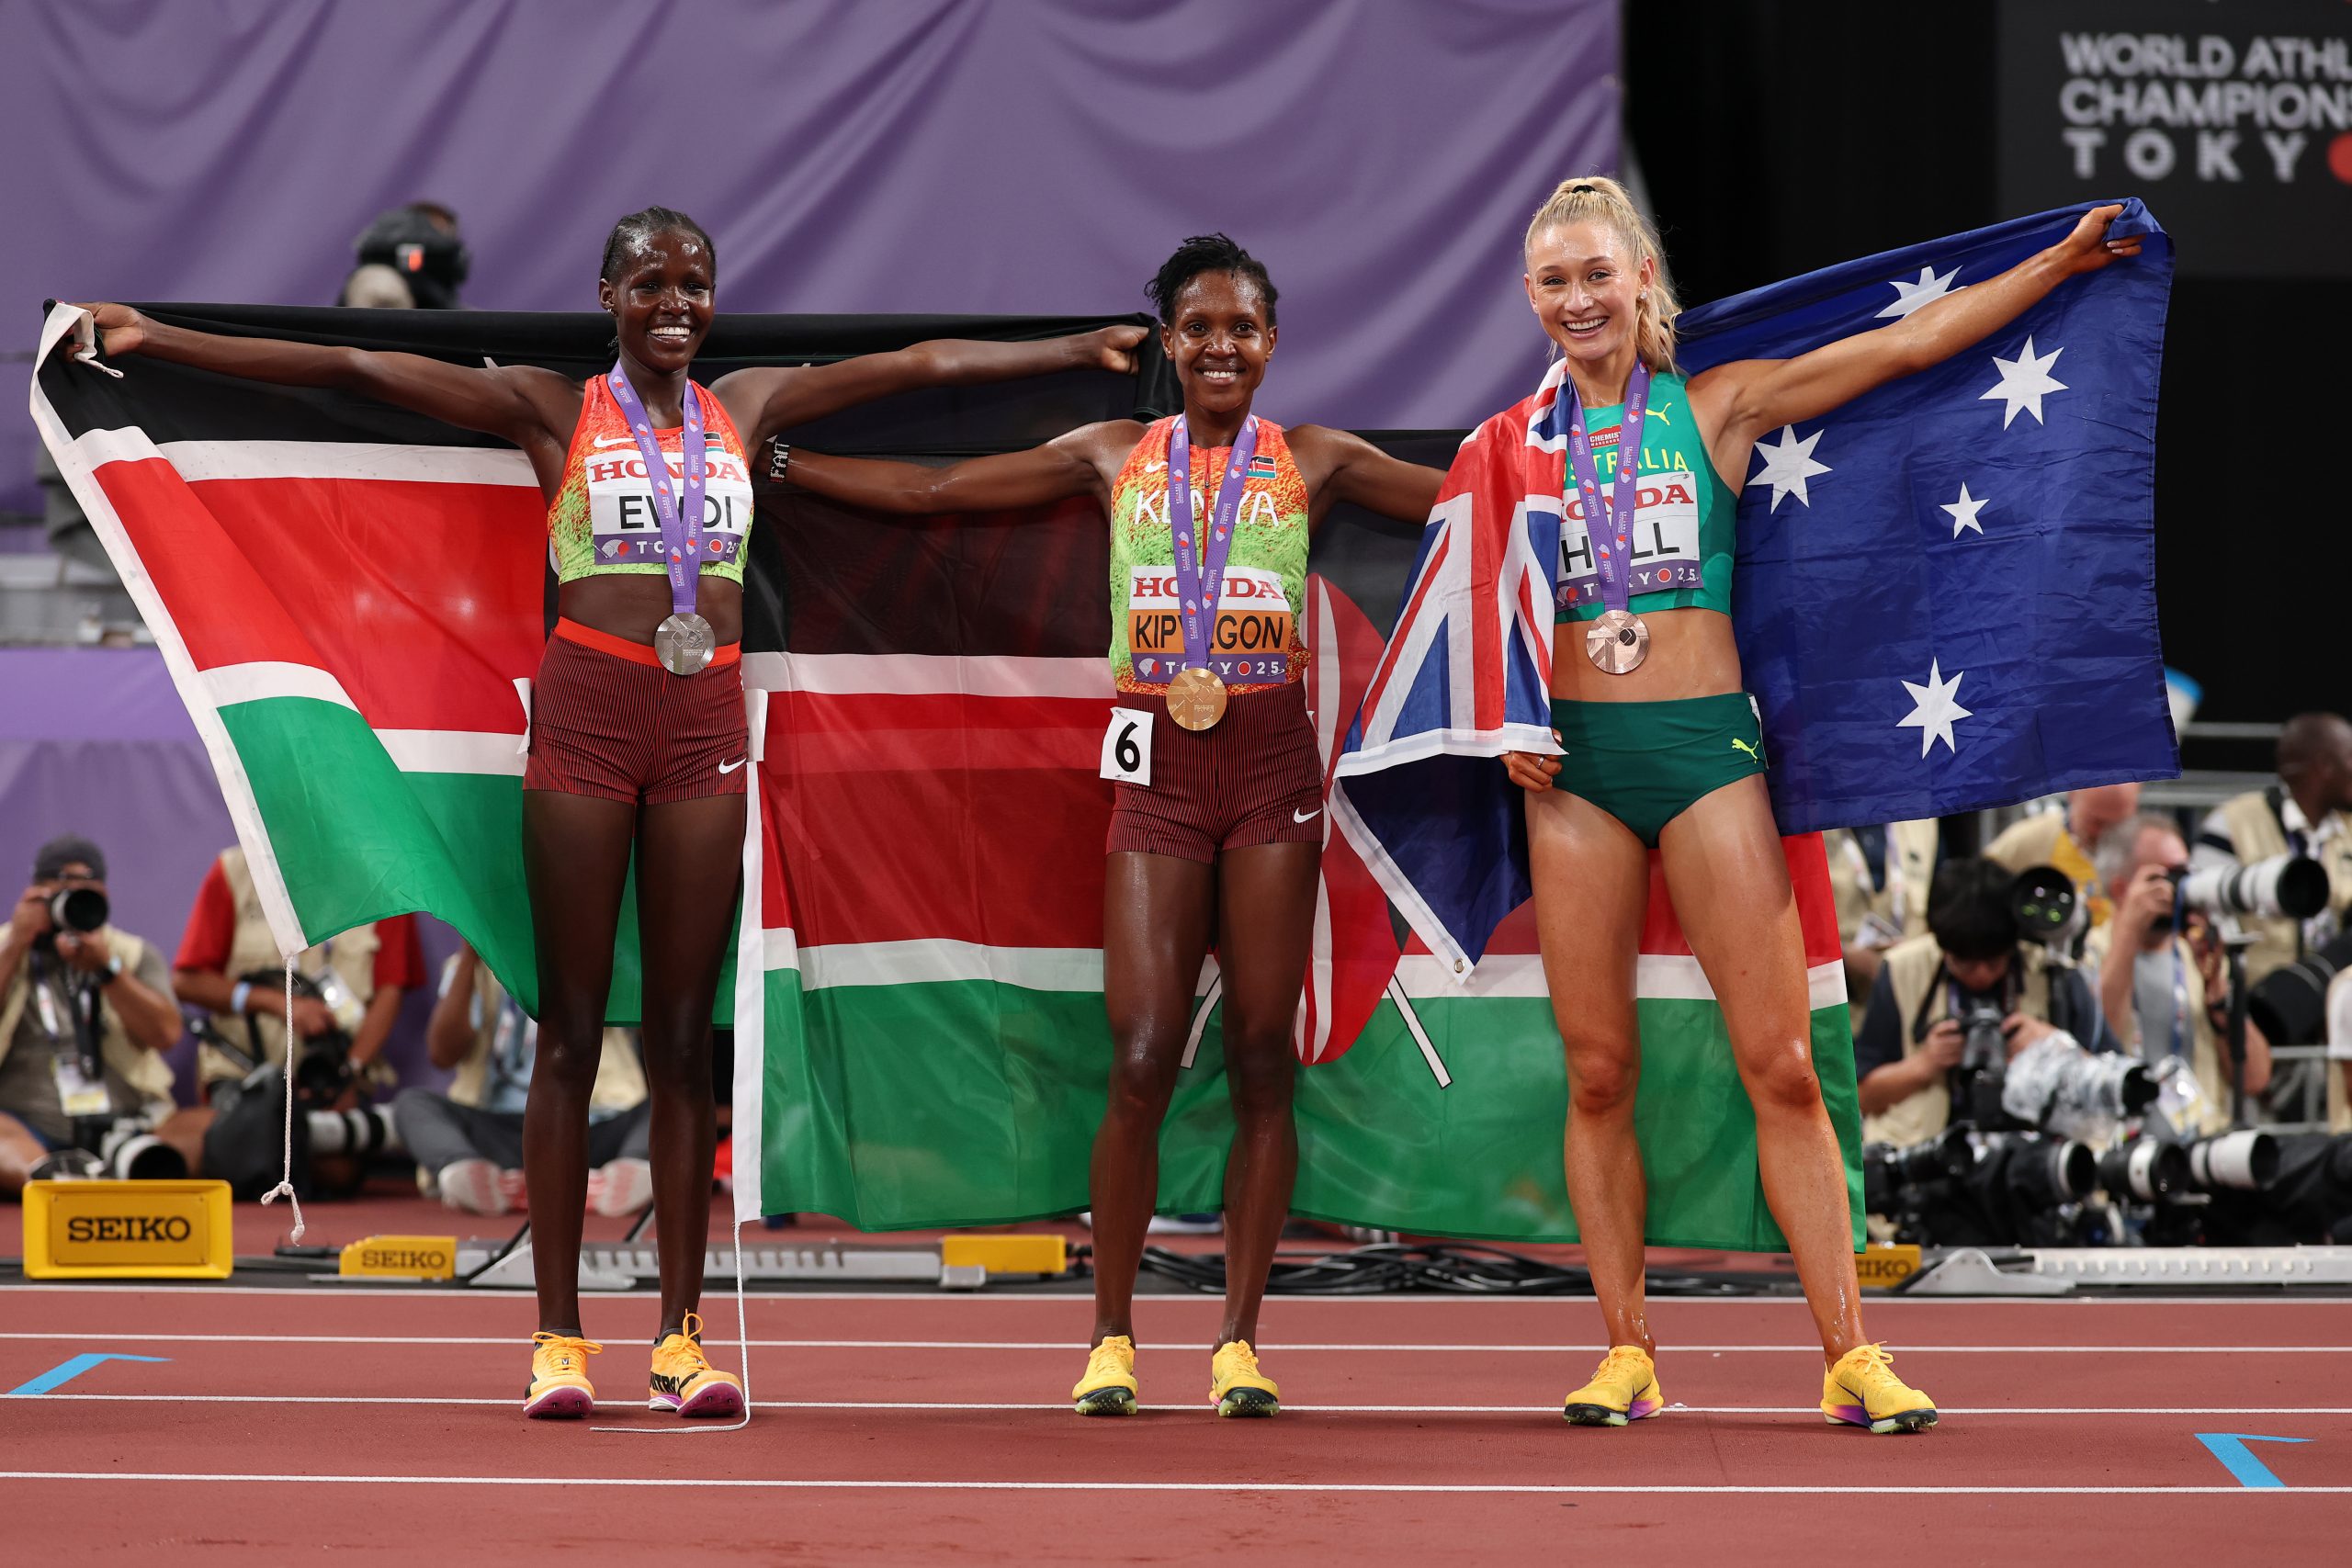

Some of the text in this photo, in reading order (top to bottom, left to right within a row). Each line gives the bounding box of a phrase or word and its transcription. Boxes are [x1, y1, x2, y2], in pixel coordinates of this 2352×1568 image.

[2060, 33, 2234, 78] WORLD
[1561, 522, 1680, 573] HLL
[1677, 567, 1697, 581] 25
[1133, 576, 1283, 600] HODA
[1136, 615, 1283, 649] KIPGON
[1256, 661, 1279, 675] 25
[1114, 721, 1141, 773] 6
[68, 1216, 191, 1242] SEIKO
[361, 1249, 447, 1270] SEIKO
[1856, 1259, 1912, 1279] EIKO
